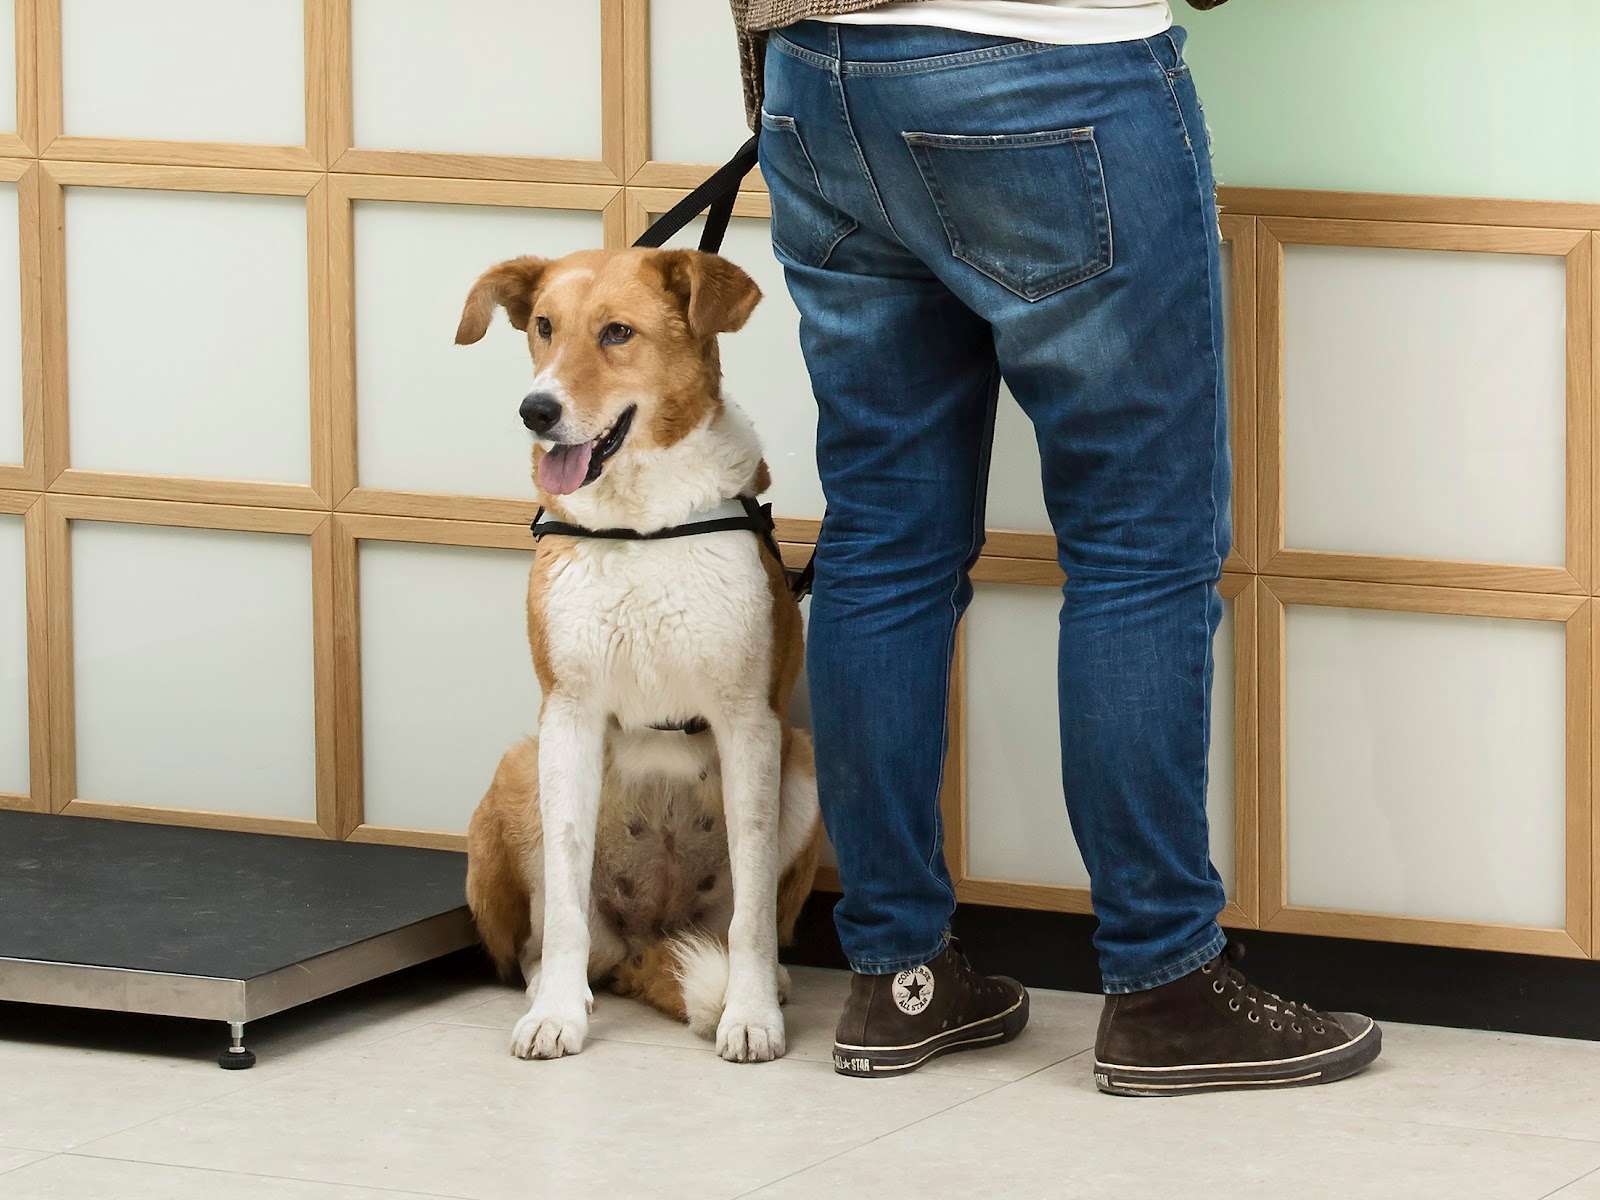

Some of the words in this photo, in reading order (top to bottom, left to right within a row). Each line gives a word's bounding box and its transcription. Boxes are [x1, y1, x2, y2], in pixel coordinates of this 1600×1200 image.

[897, 966, 932, 985] CONVERSE
[911, 997, 929, 1011] STAR
[851, 1058, 870, 1072] STAR
